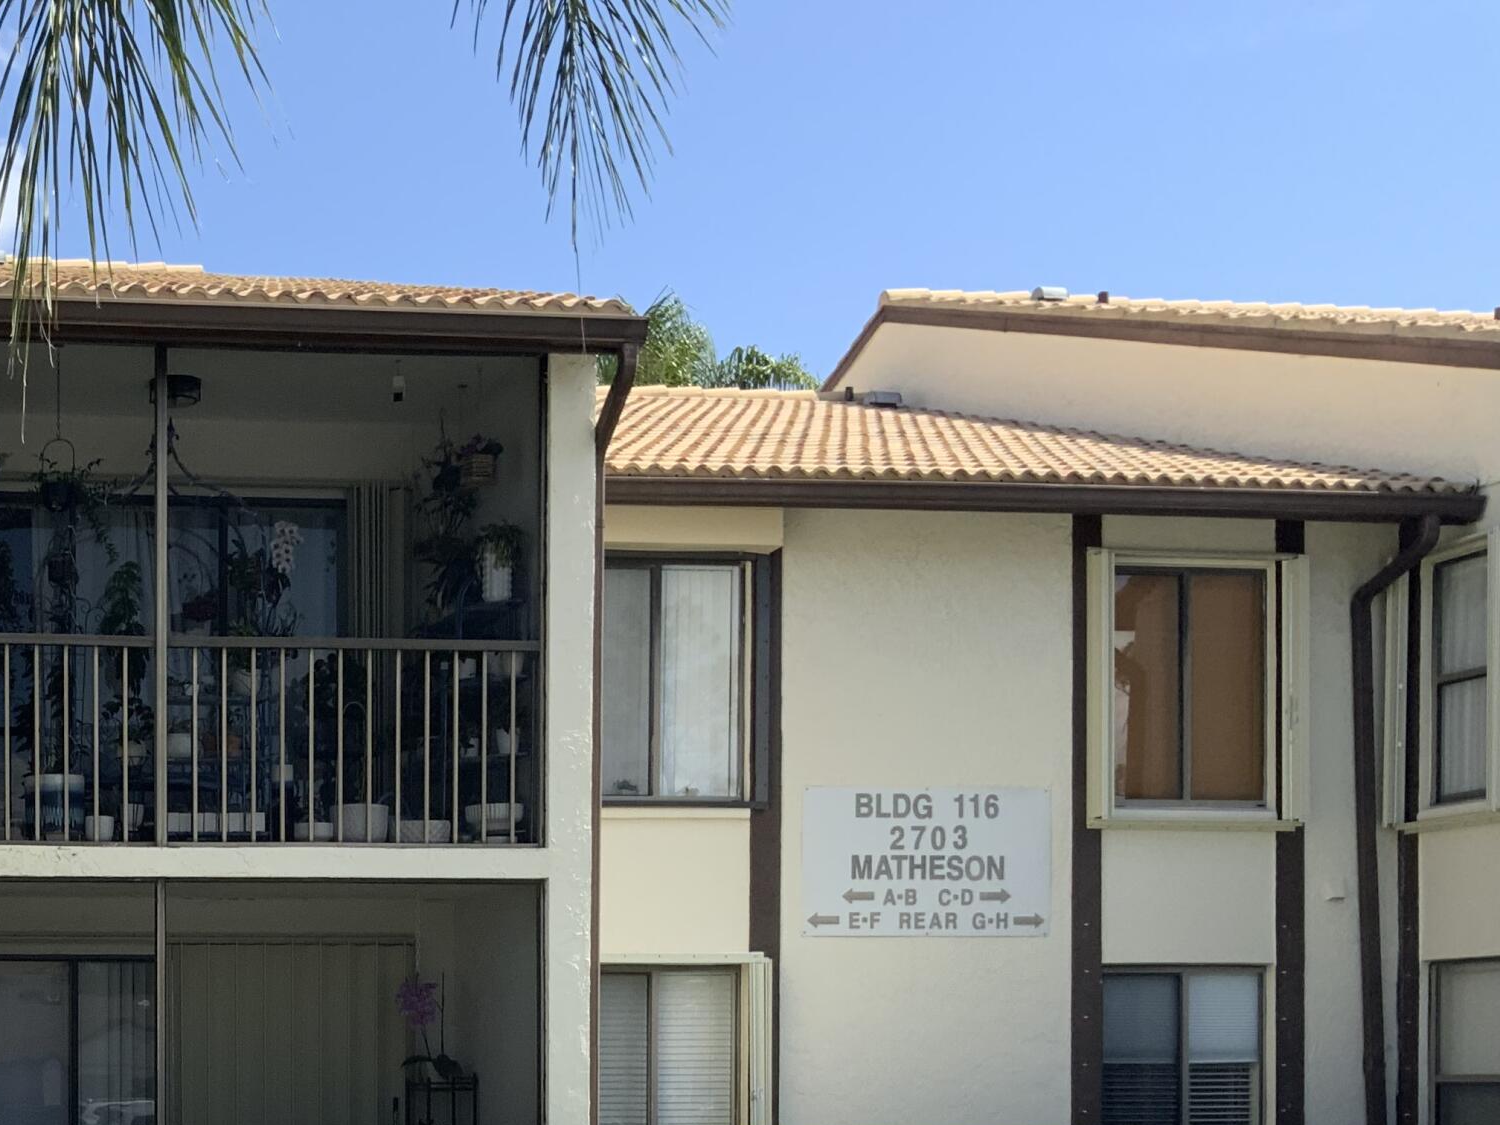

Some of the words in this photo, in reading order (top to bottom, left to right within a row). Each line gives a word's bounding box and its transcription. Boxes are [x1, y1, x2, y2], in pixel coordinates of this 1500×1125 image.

[854, 793, 933, 819] BLDG
[953, 793, 1000, 819] 116
[889, 825, 968, 851] 2703
[850, 854, 1005, 880] MATHESON
[898, 912, 958, 929] REAR
